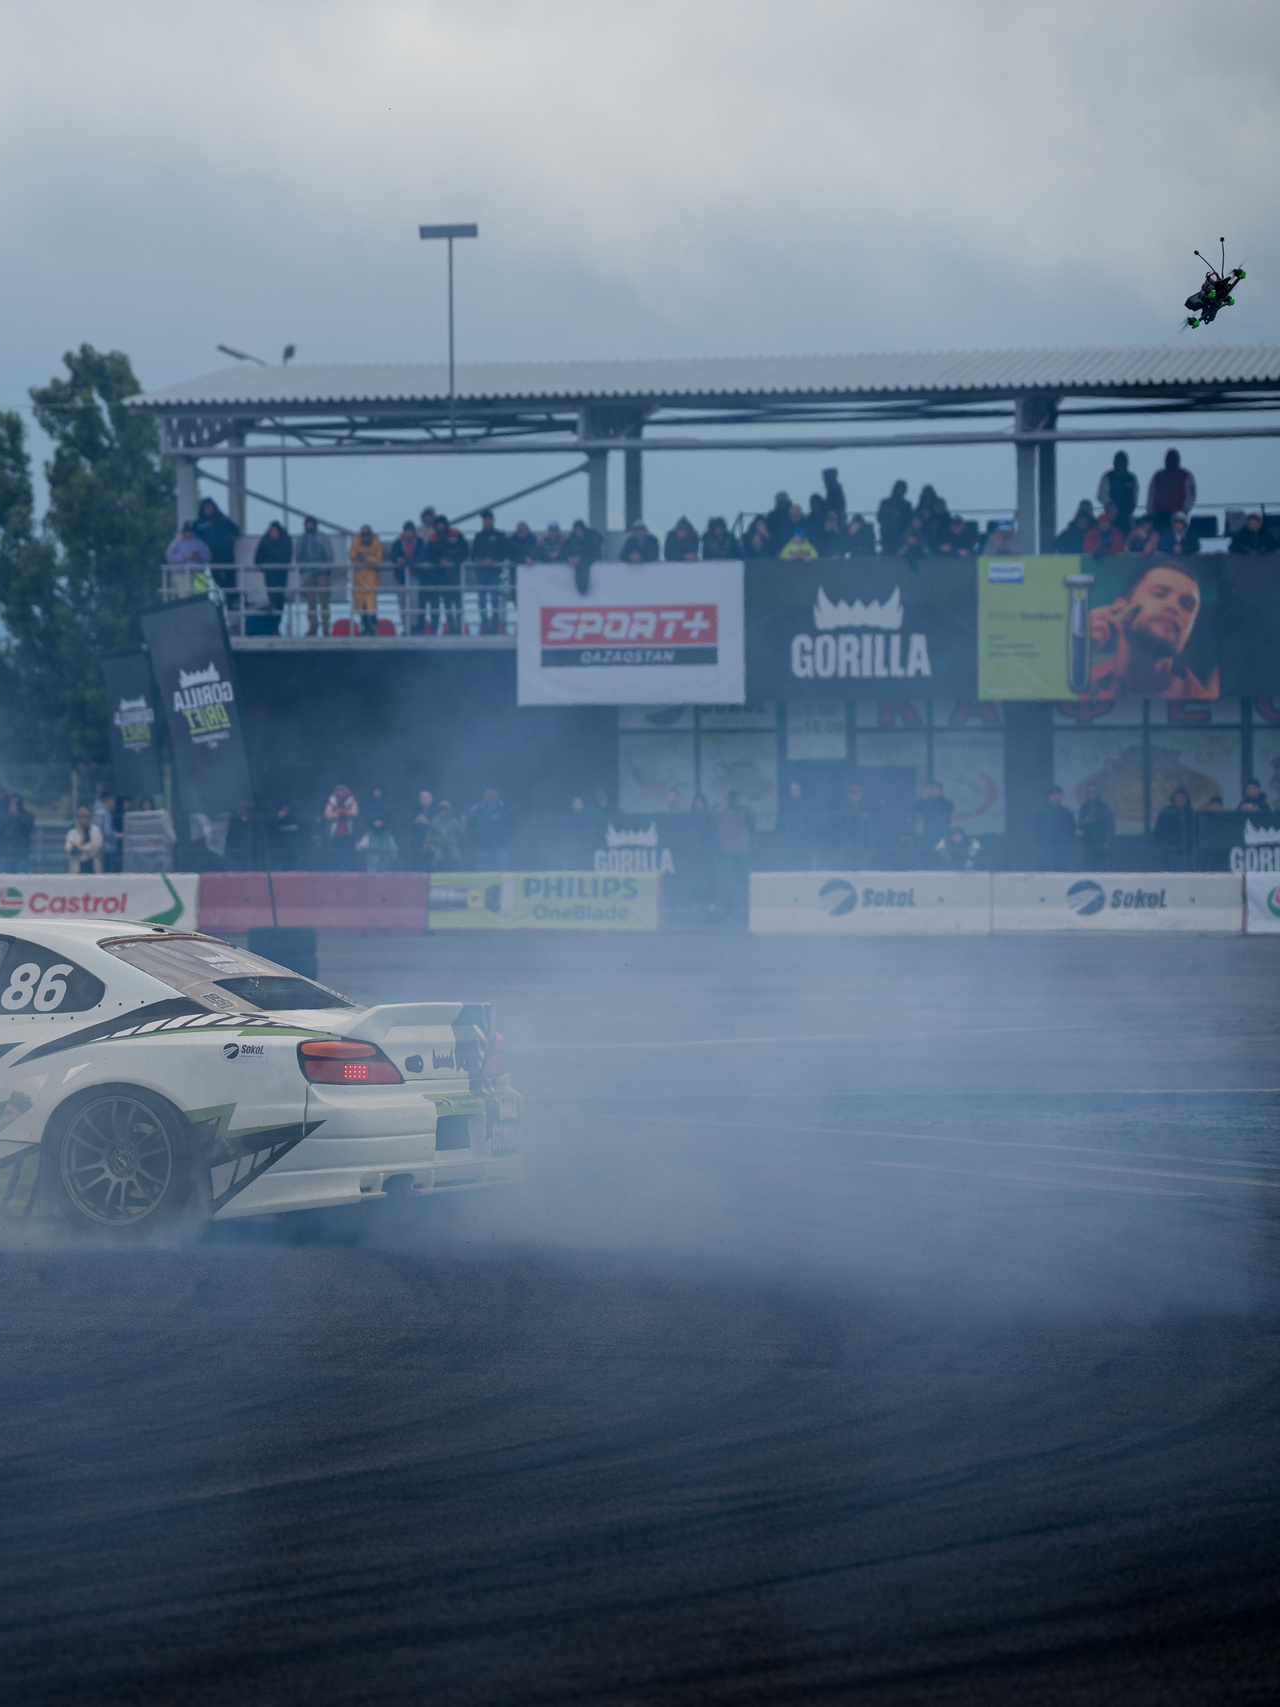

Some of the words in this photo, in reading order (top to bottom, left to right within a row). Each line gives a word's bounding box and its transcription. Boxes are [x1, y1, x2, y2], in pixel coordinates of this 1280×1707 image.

[547, 610, 711, 640] SPORT+
[579, 648, 675, 665] QAZAQSTAN
[790, 632, 932, 679] GORILLA
[593, 848, 676, 873] GORILLA
[522, 877, 639, 899] PHILIPS
[27, 892, 128, 915] Castrol
[531, 902, 629, 921] OneBlade
[1, 962, 74, 1012] 86
